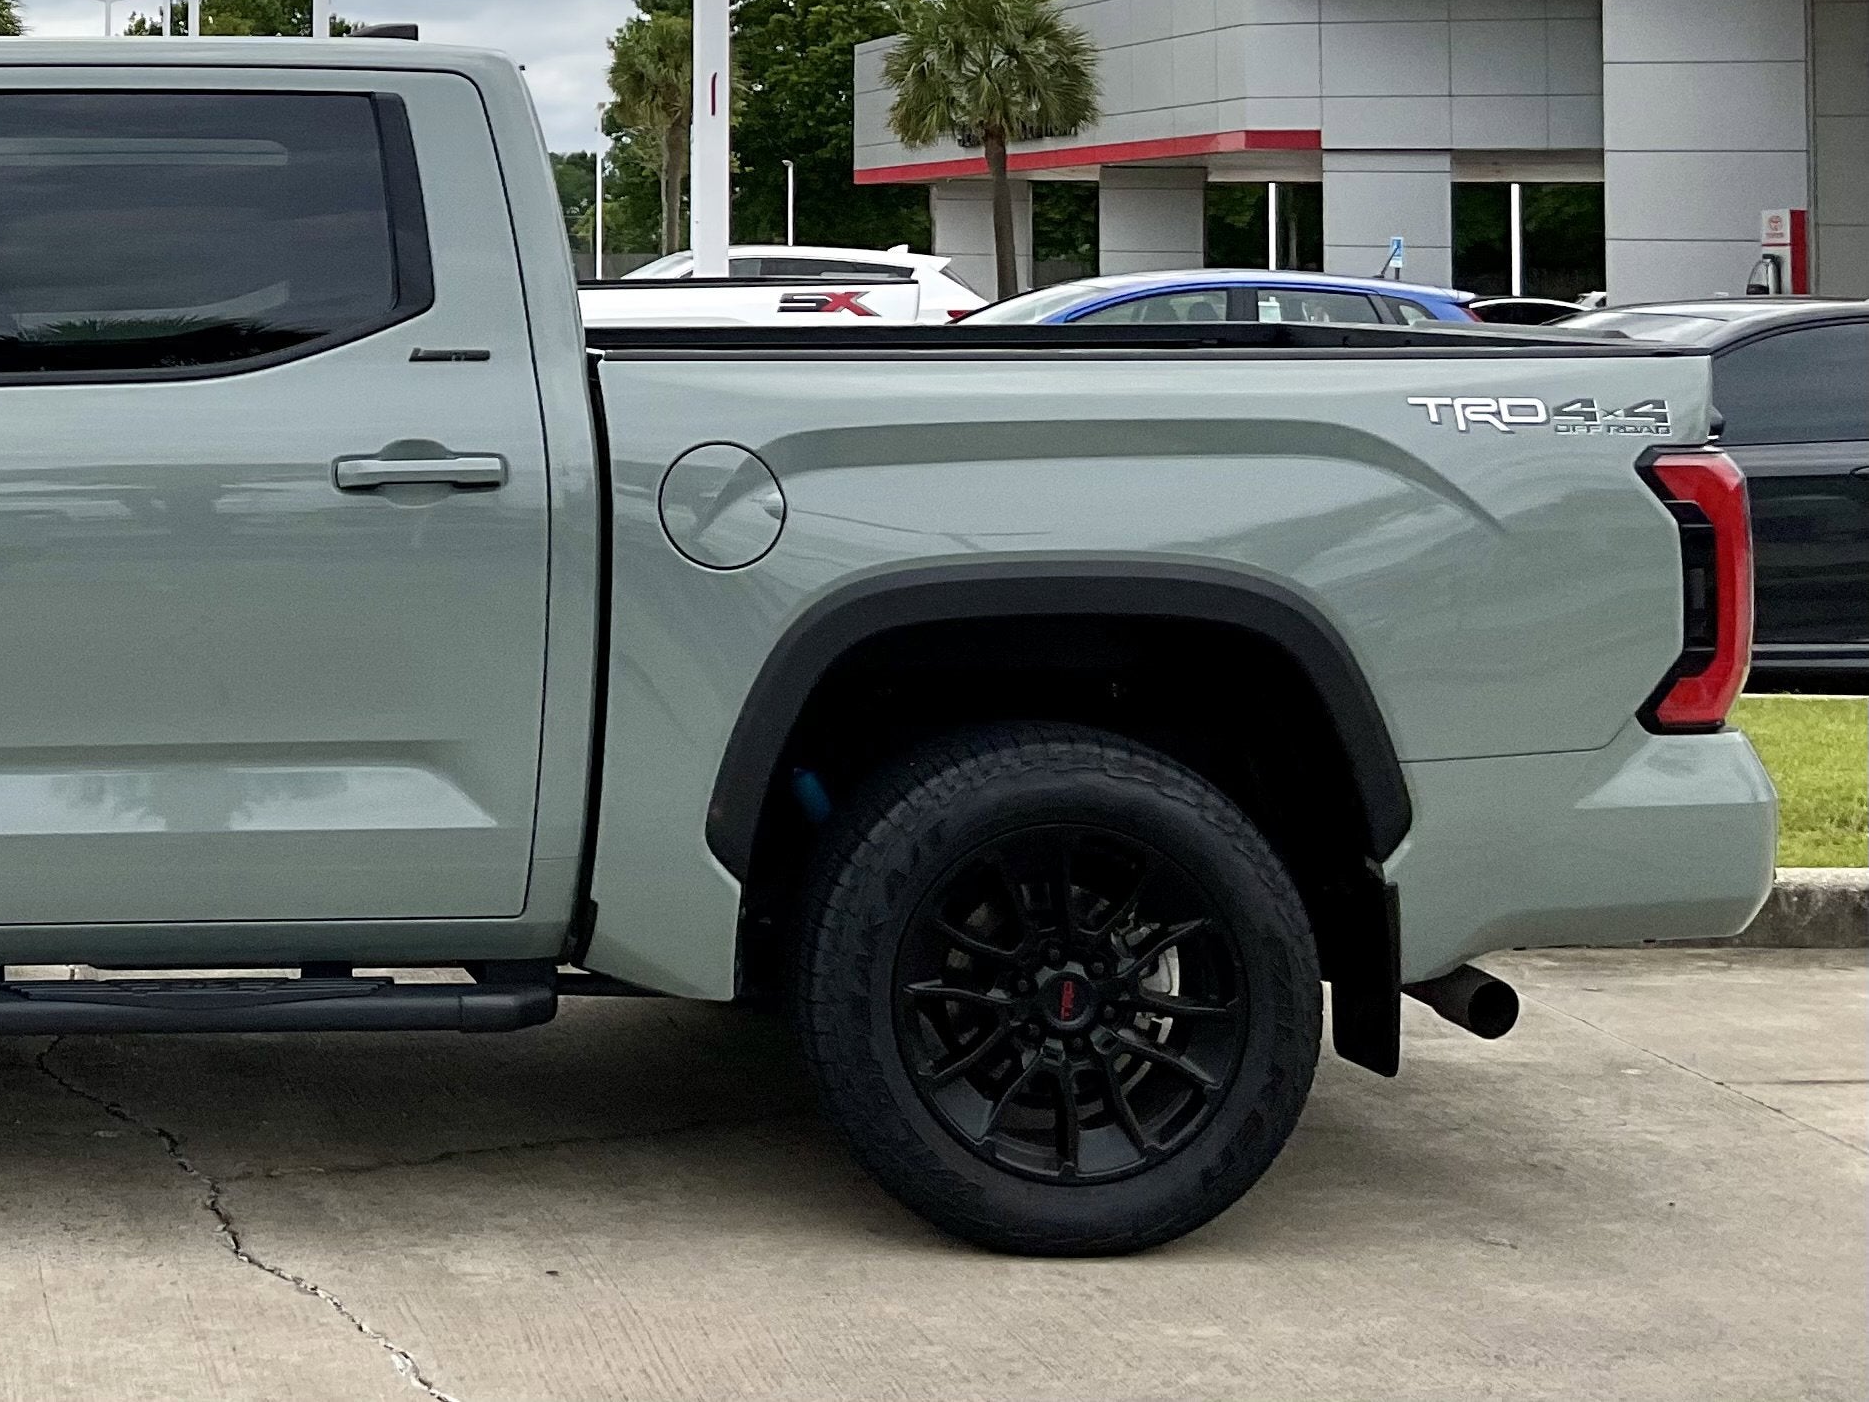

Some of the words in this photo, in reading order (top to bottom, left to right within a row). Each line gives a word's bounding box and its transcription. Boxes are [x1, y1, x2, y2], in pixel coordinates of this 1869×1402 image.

[777, 291, 882, 317] SX
[1406, 396, 1551, 434] TRD
[1554, 423, 1602, 436] OFF
[1606, 425, 1672, 437] ROAD
